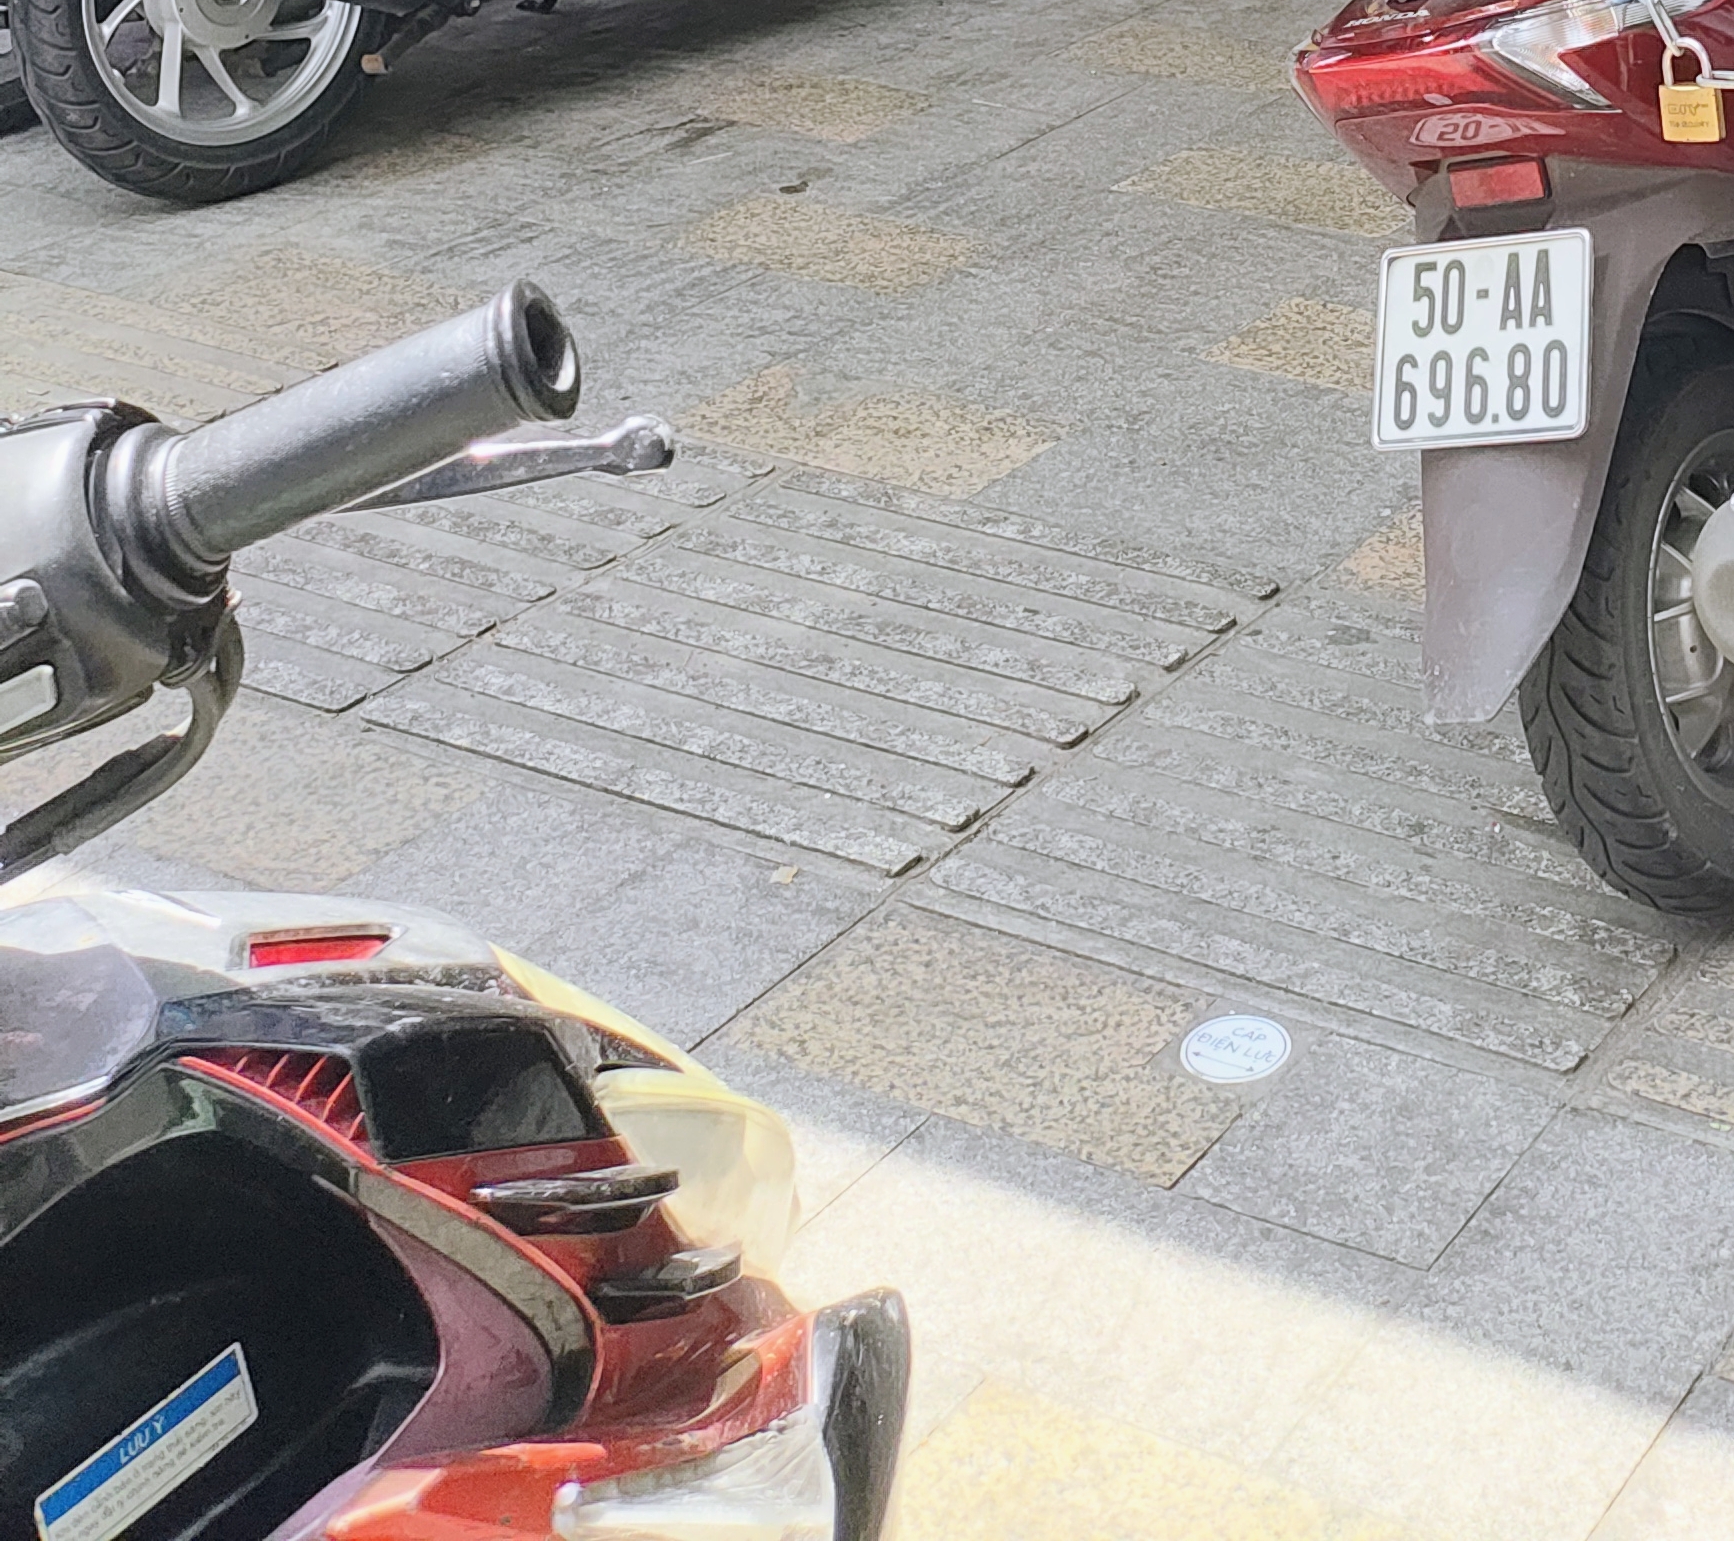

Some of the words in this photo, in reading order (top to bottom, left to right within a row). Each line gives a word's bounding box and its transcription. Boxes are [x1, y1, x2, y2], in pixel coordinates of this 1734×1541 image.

[1343, 9, 1431, 29] HONDA
[1410, 247, 1555, 338] 50-AA
[1392, 338, 1570, 432] 696.80
[1196, 1031, 1242, 1055] ĐIỆN
[1243, 1046, 1278, 1064] LỰC
[1231, 1026, 1268, 1043] CÁP
